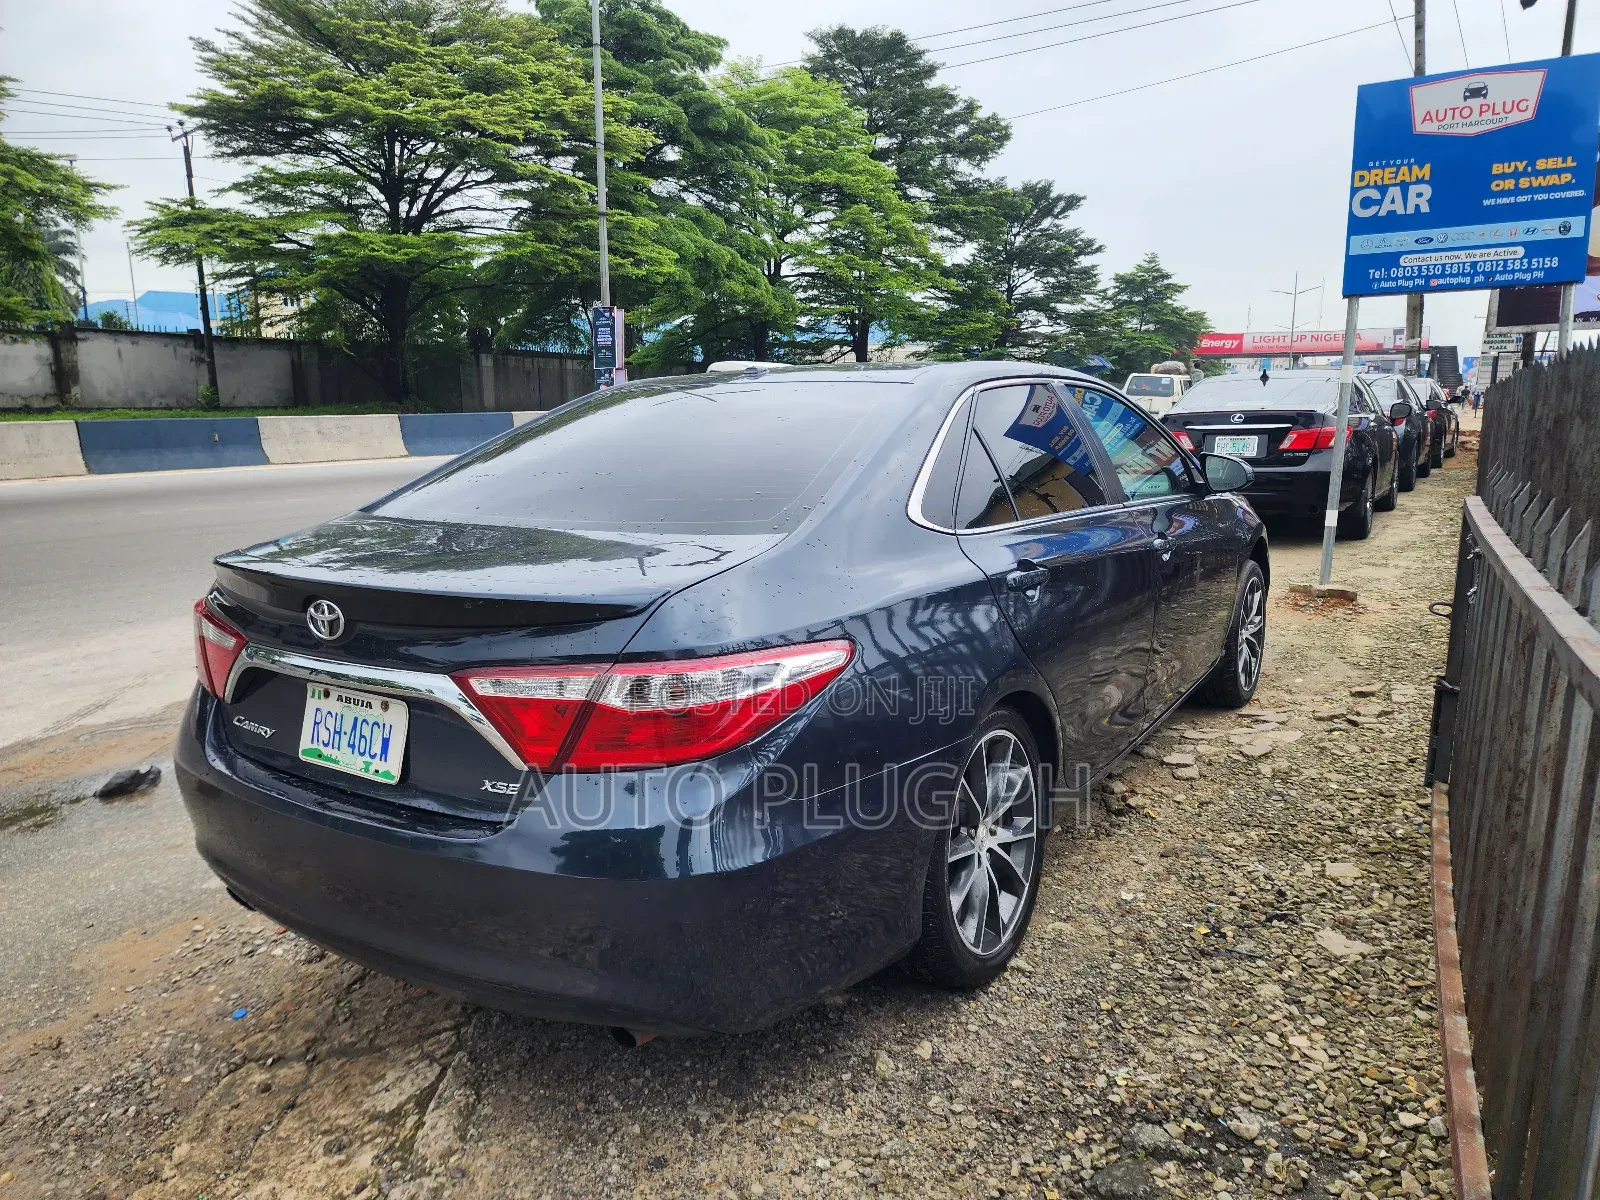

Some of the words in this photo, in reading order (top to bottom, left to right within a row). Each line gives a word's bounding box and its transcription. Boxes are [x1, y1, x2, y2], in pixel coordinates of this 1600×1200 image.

[1421, 105, 1473, 124] AUTO
[1479, 98, 1529, 117] PLUG
[1437, 122, 1460, 131] PORT
[1461, 116, 1509, 128] HARCOURT
[1491, 161, 1532, 174] BUY,
[1535, 156, 1577, 170] SELL
[1353, 163, 1431, 187] DREAM
[1490, 179, 1515, 191] OR
[1518, 173, 1576, 188] SWAP.
[1352, 184, 1432, 217] CAR
[1482, 198, 1496, 206] WE
[1496, 196, 1516, 204] HAVE
[1516, 194, 1532, 202] GOT
[1533, 193, 1548, 201] YOU
[1549, 189, 1587, 199] COVERED.
[1403, 255, 1432, 264] Contact
[1464, 252, 1477, 260] We
[1493, 248, 1520, 257] Active.
[1368, 268, 1388, 279] Tel:
[1390, 265, 1419, 278] 0803
[1420, 264, 1443, 276] 530
[1444, 261, 1474, 274] 5815,
[1476, 260, 1504, 272] 0812
[1506, 258, 1529, 271] 583
[1530, 257, 1559, 269] 5158
[1494, 273, 1513, 282] Auto
[1513, 271, 1531, 281] Plug
[1532, 270, 1544, 279] PH
[1379, 280, 1397, 288] Auto
[1397, 279, 1414, 288] Plug
[1414, 278, 1425, 286] PH
[1201, 339, 1240, 349] Energy
[1252, 335, 1288, 344] LIGHT
[1310, 332, 1362, 343] NIGEA
[336, 694, 373, 709] ABUJA
[232, 715, 277, 739] CAMRY
[310, 707, 393, 763] RSH-46CW
[480, 779, 521, 795] XSE
